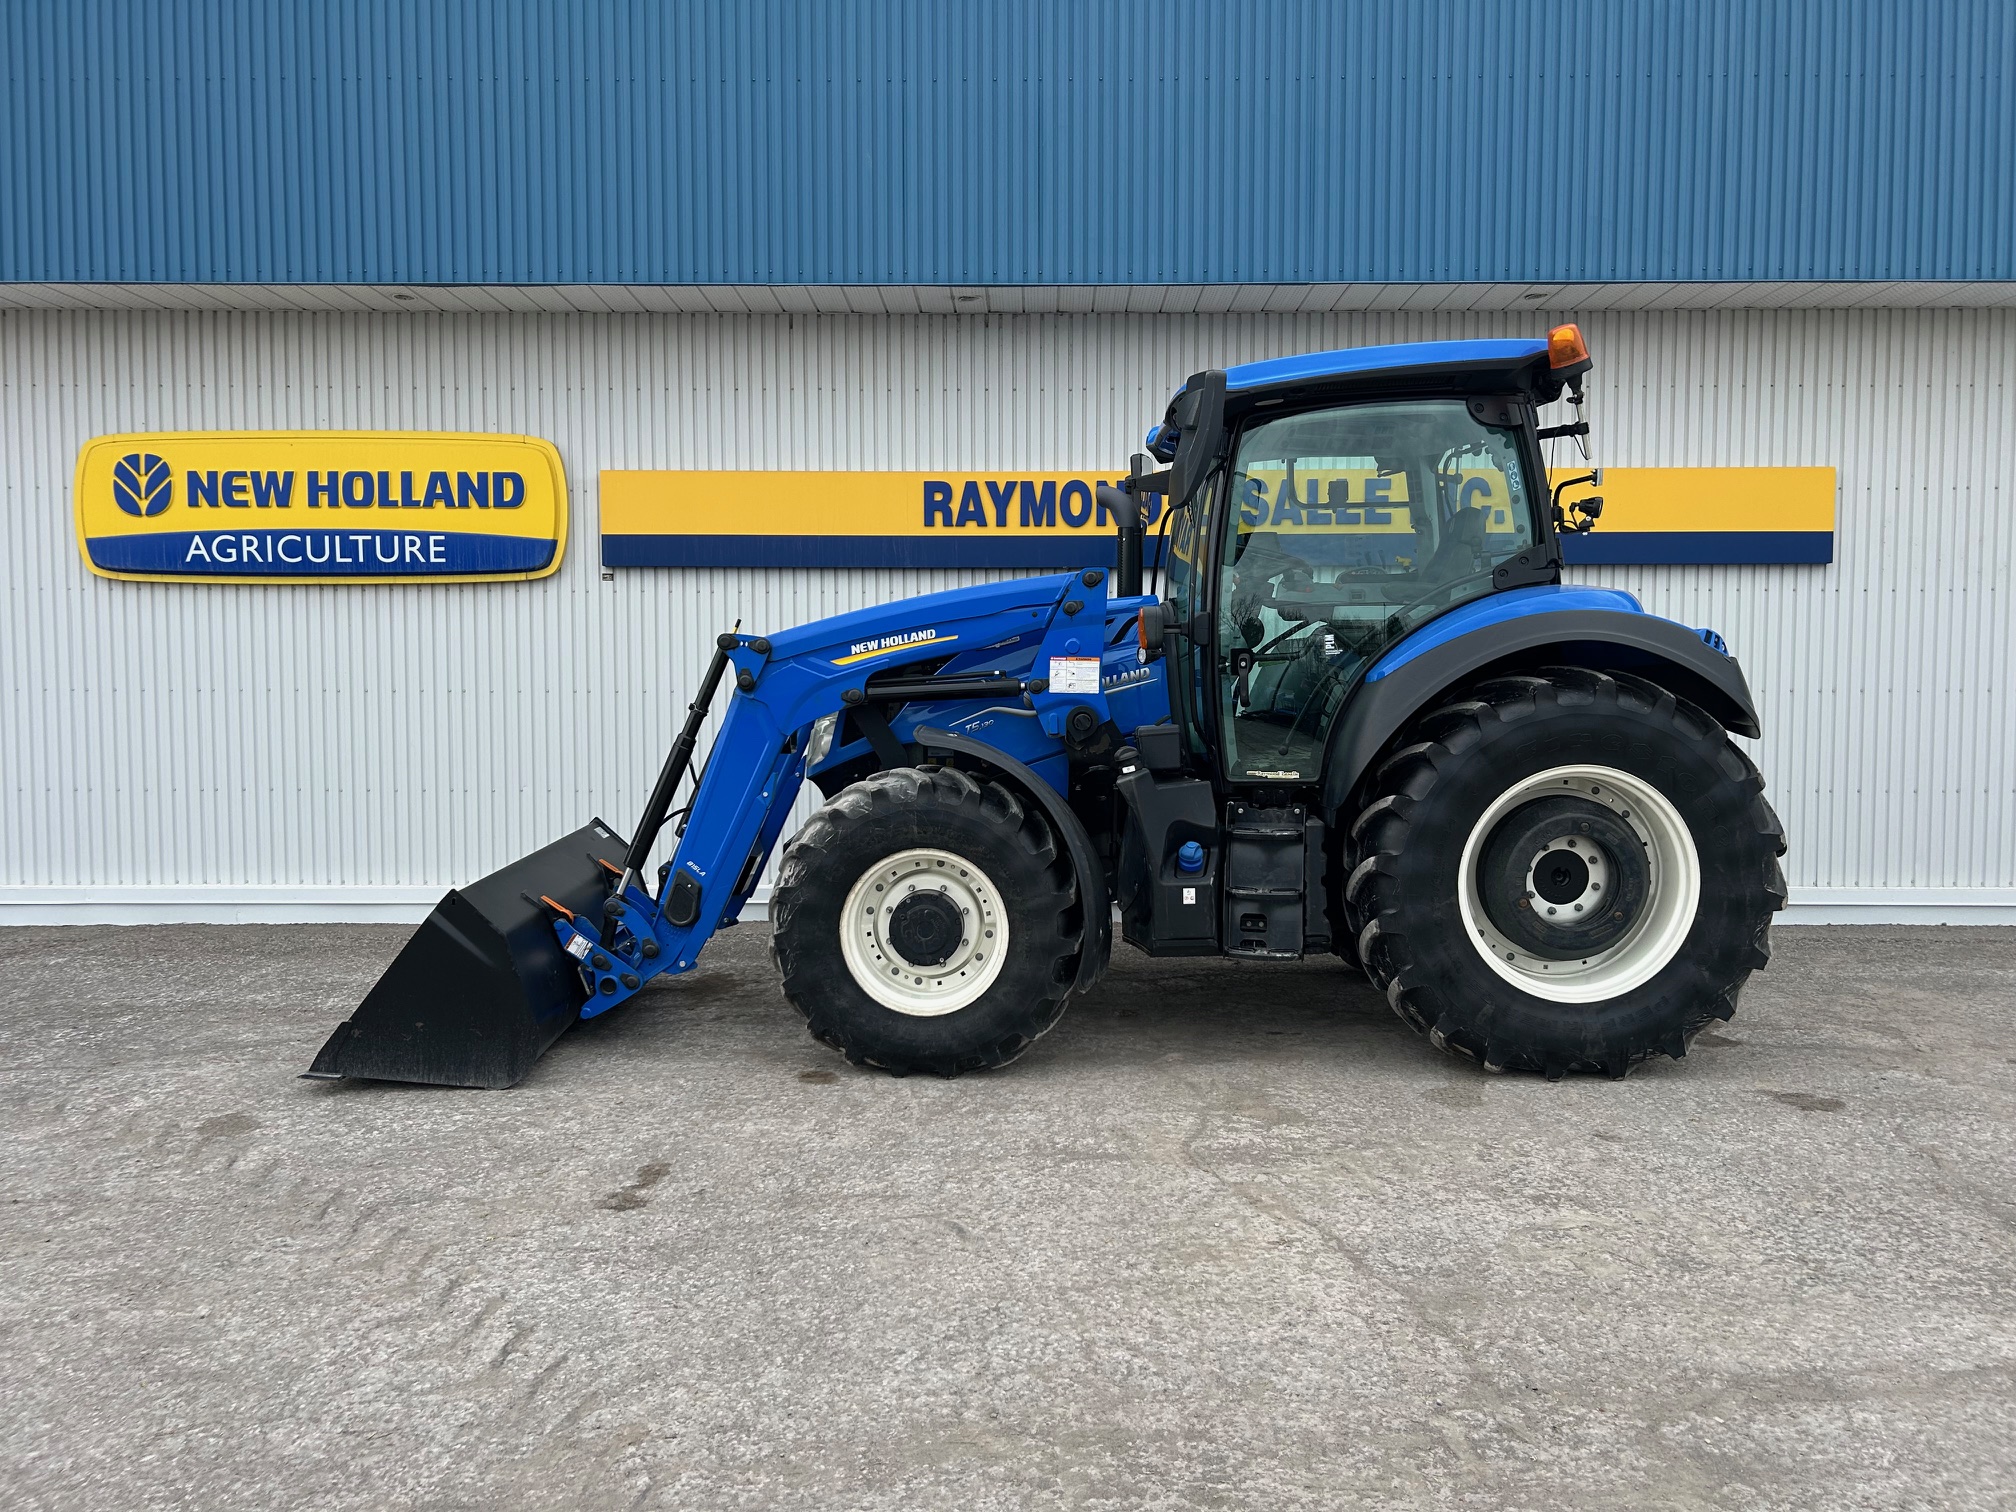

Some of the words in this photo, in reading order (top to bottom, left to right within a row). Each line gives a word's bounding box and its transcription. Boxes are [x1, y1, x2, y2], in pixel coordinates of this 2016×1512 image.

[186, 470, 294, 508] NEW
[306, 470, 525, 509] HOLLAND
[1201, 478, 1392, 527] SALLE
[185, 534, 447, 563] AGRICULTURE
[850, 640, 879, 655] NEW
[880, 628, 936, 649] HOLLAND
